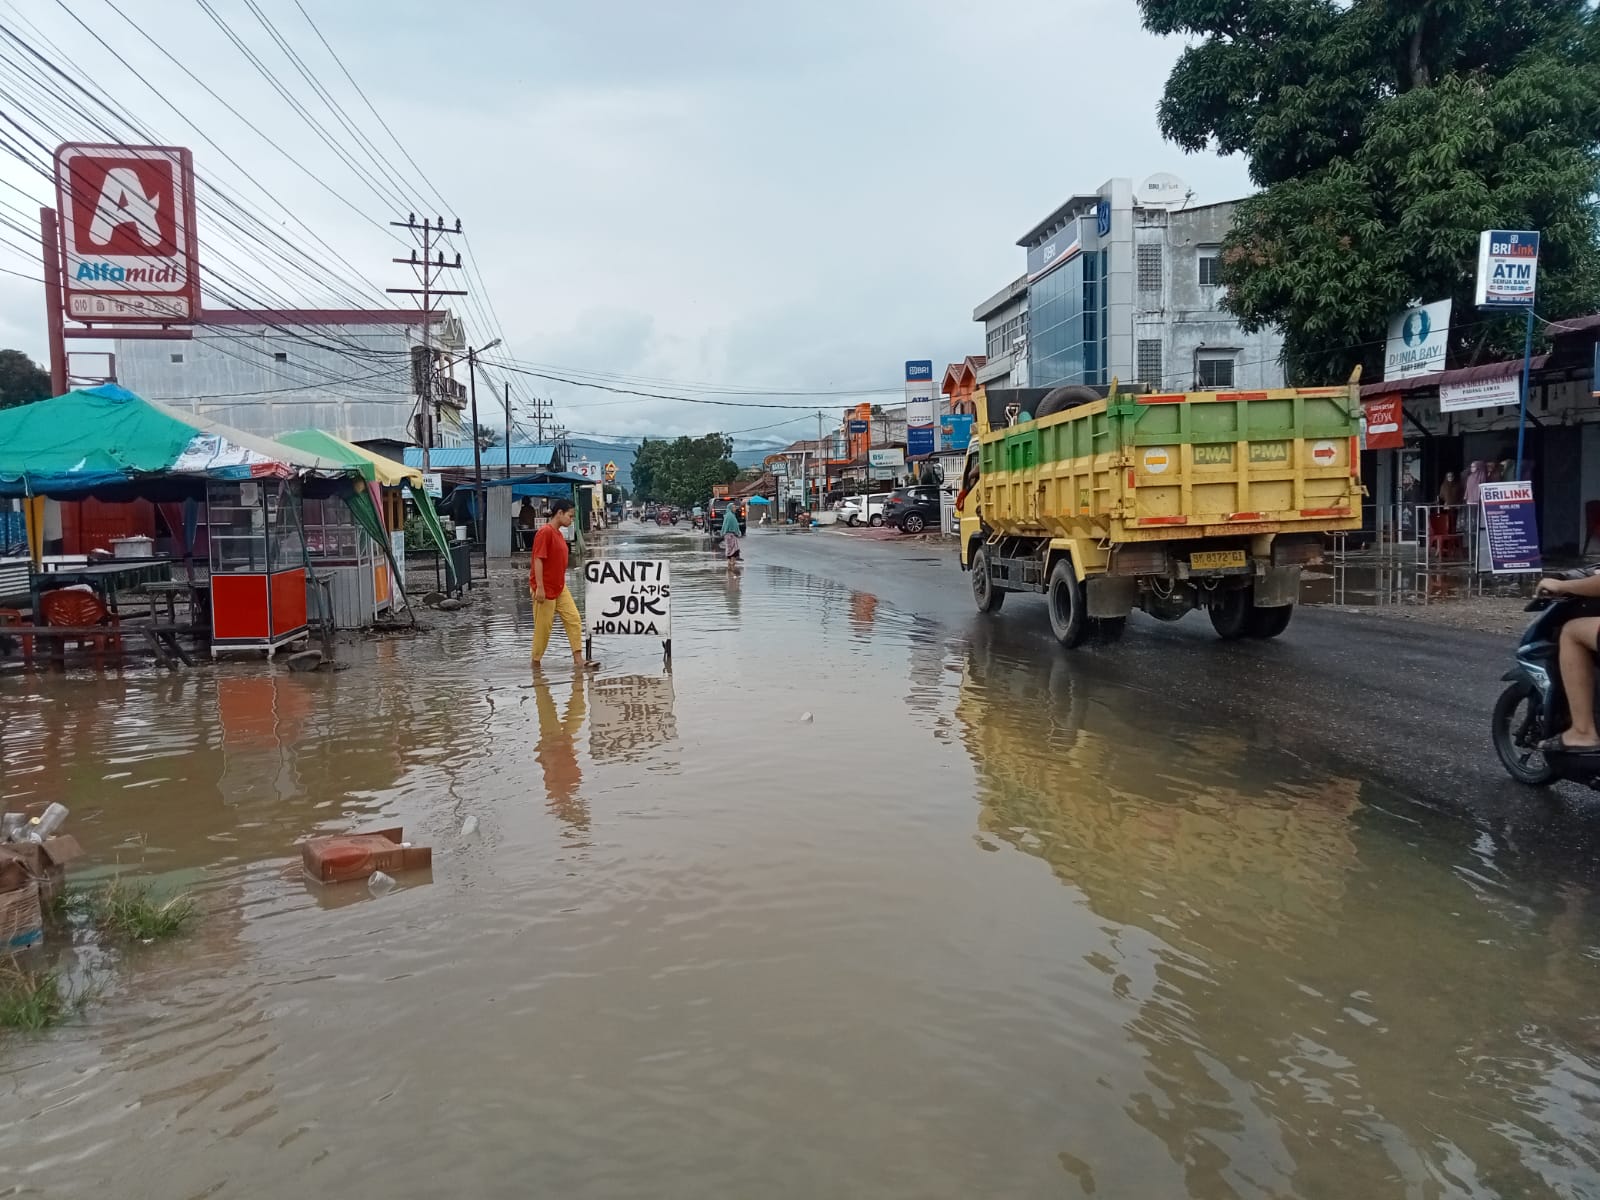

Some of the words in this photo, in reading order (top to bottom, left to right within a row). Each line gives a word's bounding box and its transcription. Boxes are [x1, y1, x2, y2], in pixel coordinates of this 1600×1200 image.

[1492, 243, 1534, 255] BRILink
[76, 262, 178, 283] Alfamidi
[1493, 264, 1531, 279] ATM
[1390, 350, 1417, 366] DUNIA
[1194, 446, 1229, 462] PMA
[1251, 444, 1285, 459] PMA
[581, 468, 588, 477] 2
[1485, 489, 1531, 500] BRILINK
[585, 561, 662, 584] GANTI
[631, 584, 670, 598] LAPIS
[602, 595, 666, 618] JOK
[592, 619, 659, 635] HONDA
